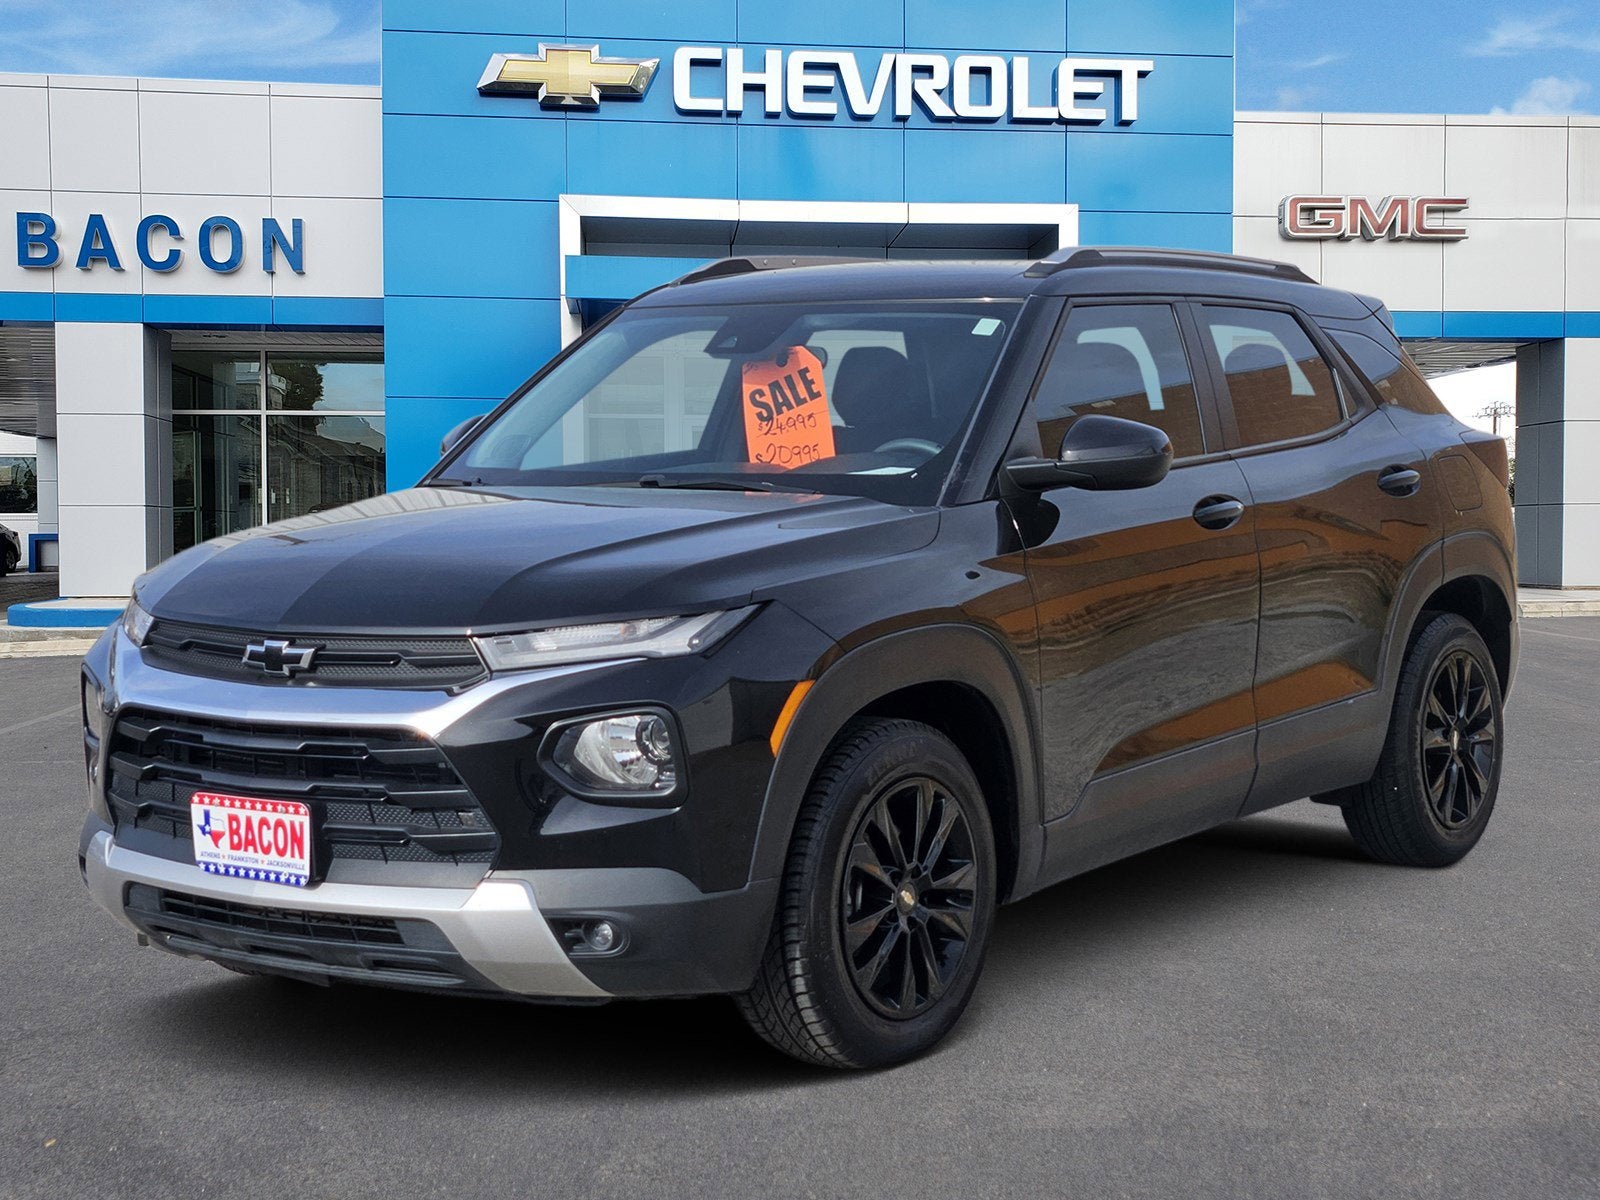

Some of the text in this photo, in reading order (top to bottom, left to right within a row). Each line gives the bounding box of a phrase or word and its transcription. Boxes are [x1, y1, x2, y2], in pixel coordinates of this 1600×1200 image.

[673, 46, 1155, 124] CHEVROLET
[16, 211, 306, 274] BACON
[1278, 194, 1470, 242] GMC
[748, 366, 822, 422] SALE
[200, 850, 305, 870] ATHENS FRANKSTON JACKSONVILLE
[228, 813, 304, 859] BACON
